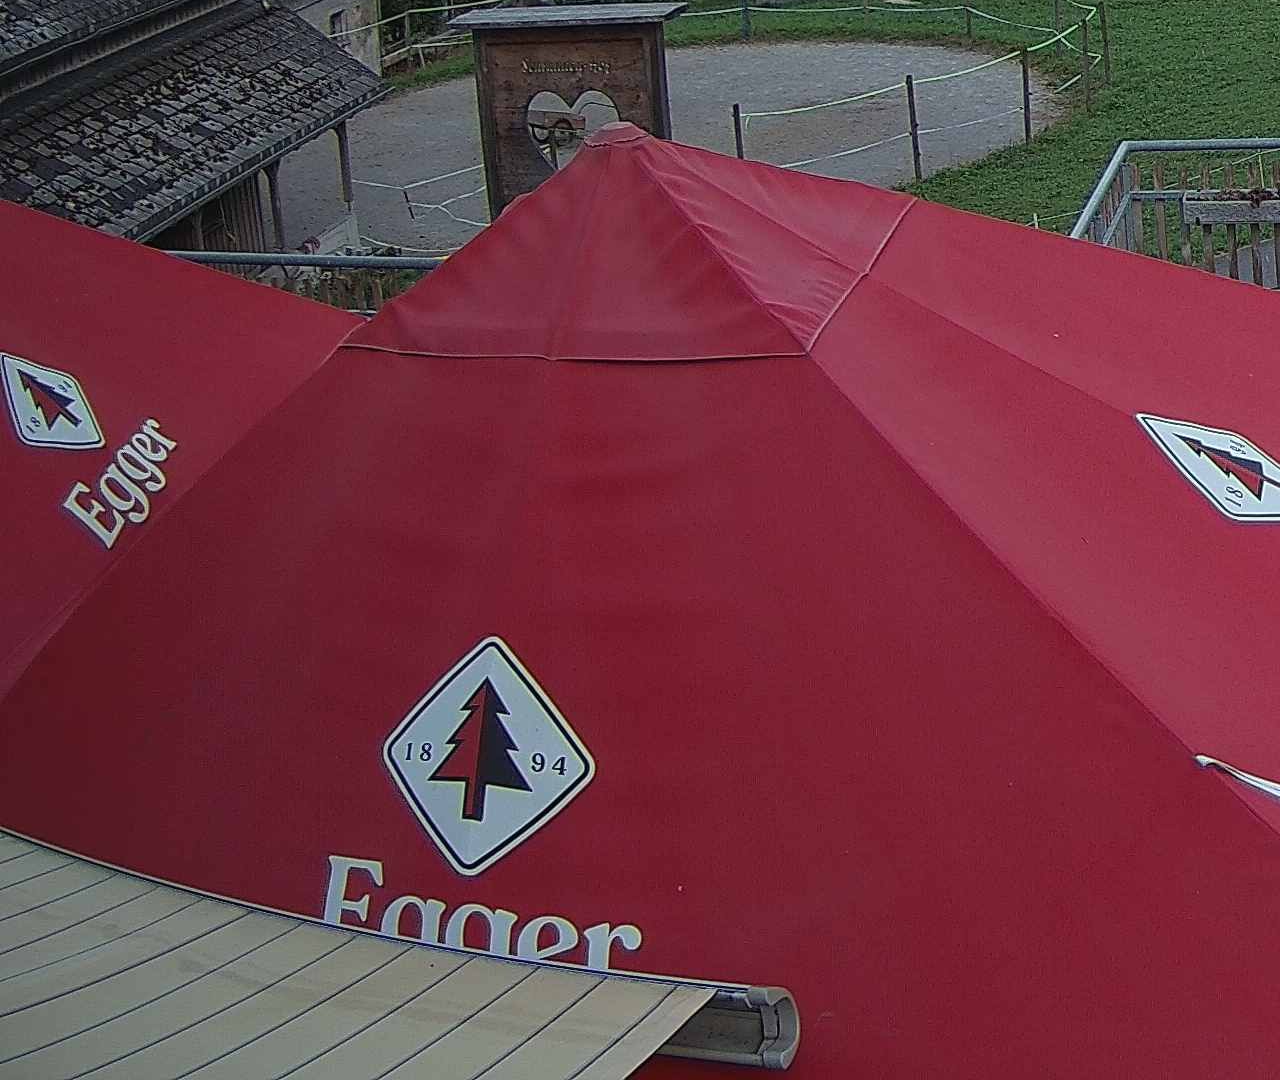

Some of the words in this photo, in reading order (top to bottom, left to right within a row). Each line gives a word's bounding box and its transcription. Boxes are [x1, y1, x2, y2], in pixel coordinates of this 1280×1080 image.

[62, 418, 178, 550] Egger
[403, 741, 433, 762] 18
[530, 752, 568, 776] 94
